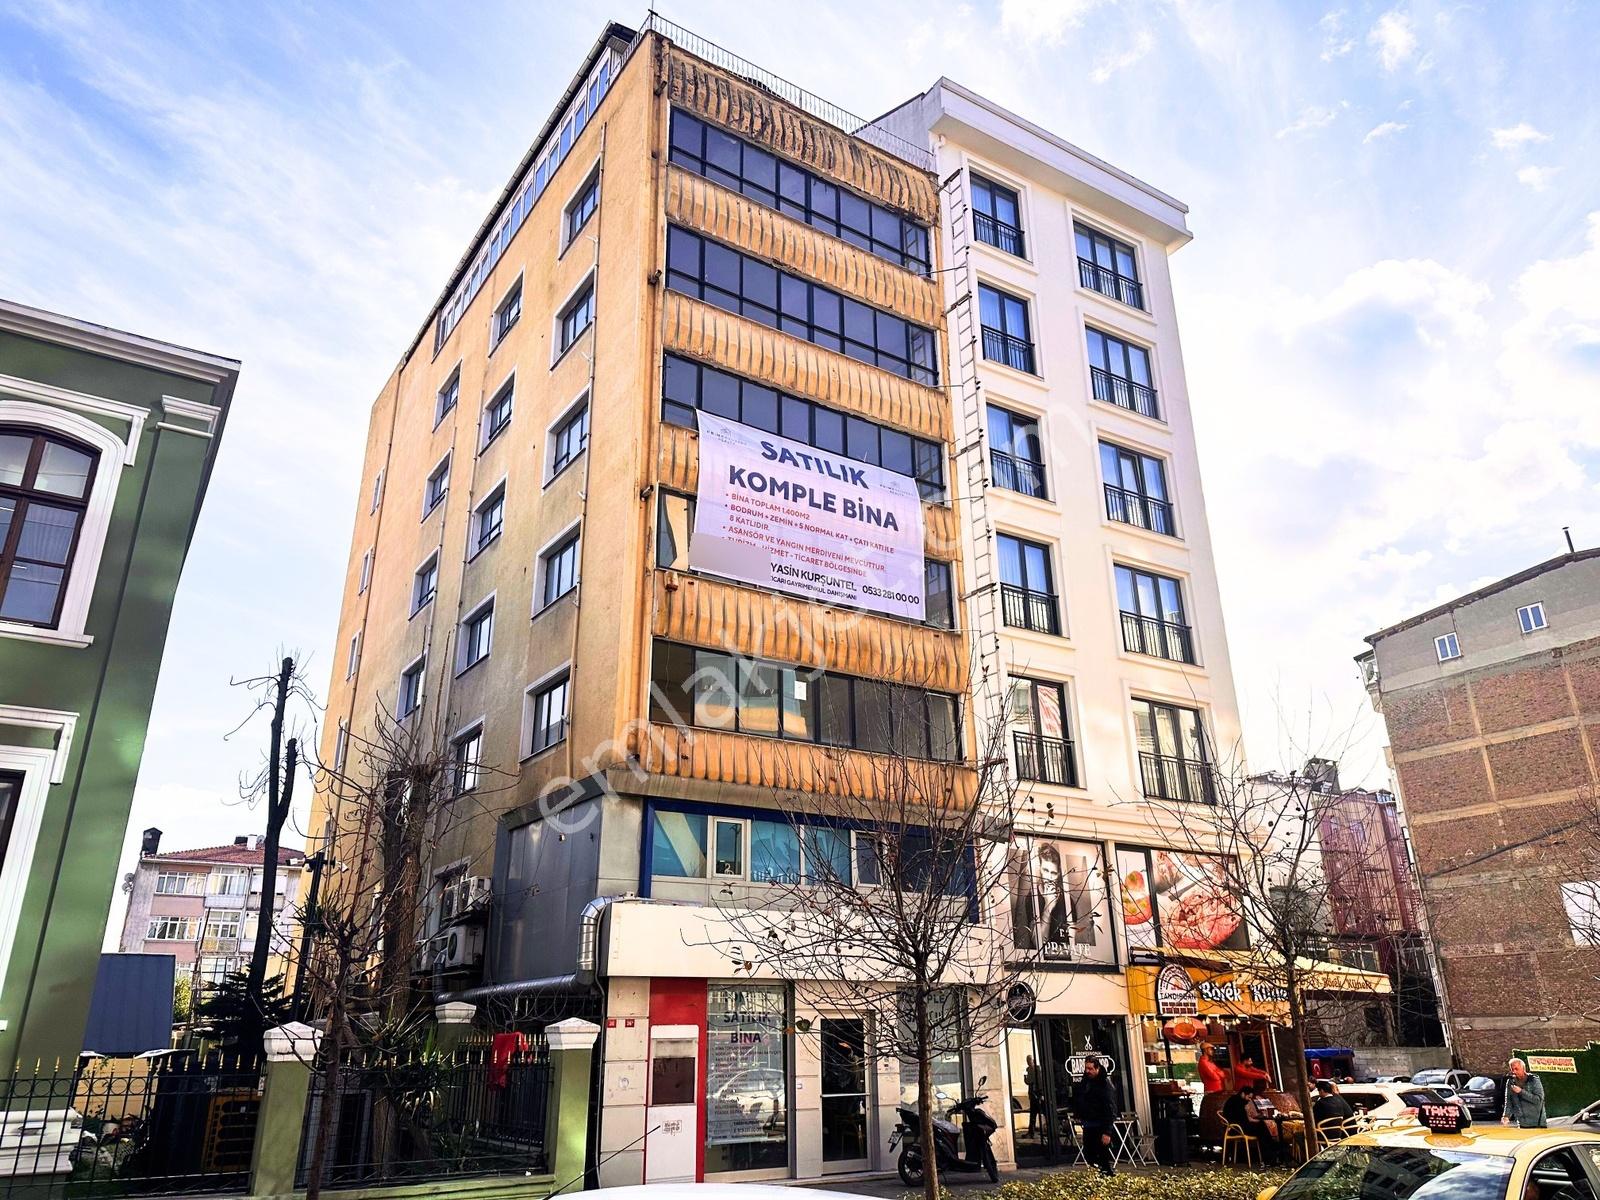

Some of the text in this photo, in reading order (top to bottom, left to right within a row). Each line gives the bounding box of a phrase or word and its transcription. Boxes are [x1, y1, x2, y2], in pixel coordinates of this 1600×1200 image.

[760, 440, 870, 490] SATILIK
[729, 464, 899, 532] KOMPLE BİNA
[731, 493, 750, 504] BİNA
[751, 498, 781, 512] TOPLAM
[730, 504, 764, 519] BODRUM
[769, 514, 793, 526] ZEMİN
[804, 523, 834, 538] NORMAL
[835, 532, 849, 541] KAT
[765, 535, 775, 544] VE
[776, 537, 804, 551] YANGIN
[770, 562, 858, 592] YASİN KURŞUNTEL
[862, 585, 882, 597] 0533
[882, 589, 895, 600] 281
[731, 1029, 761, 1043] BİNA
